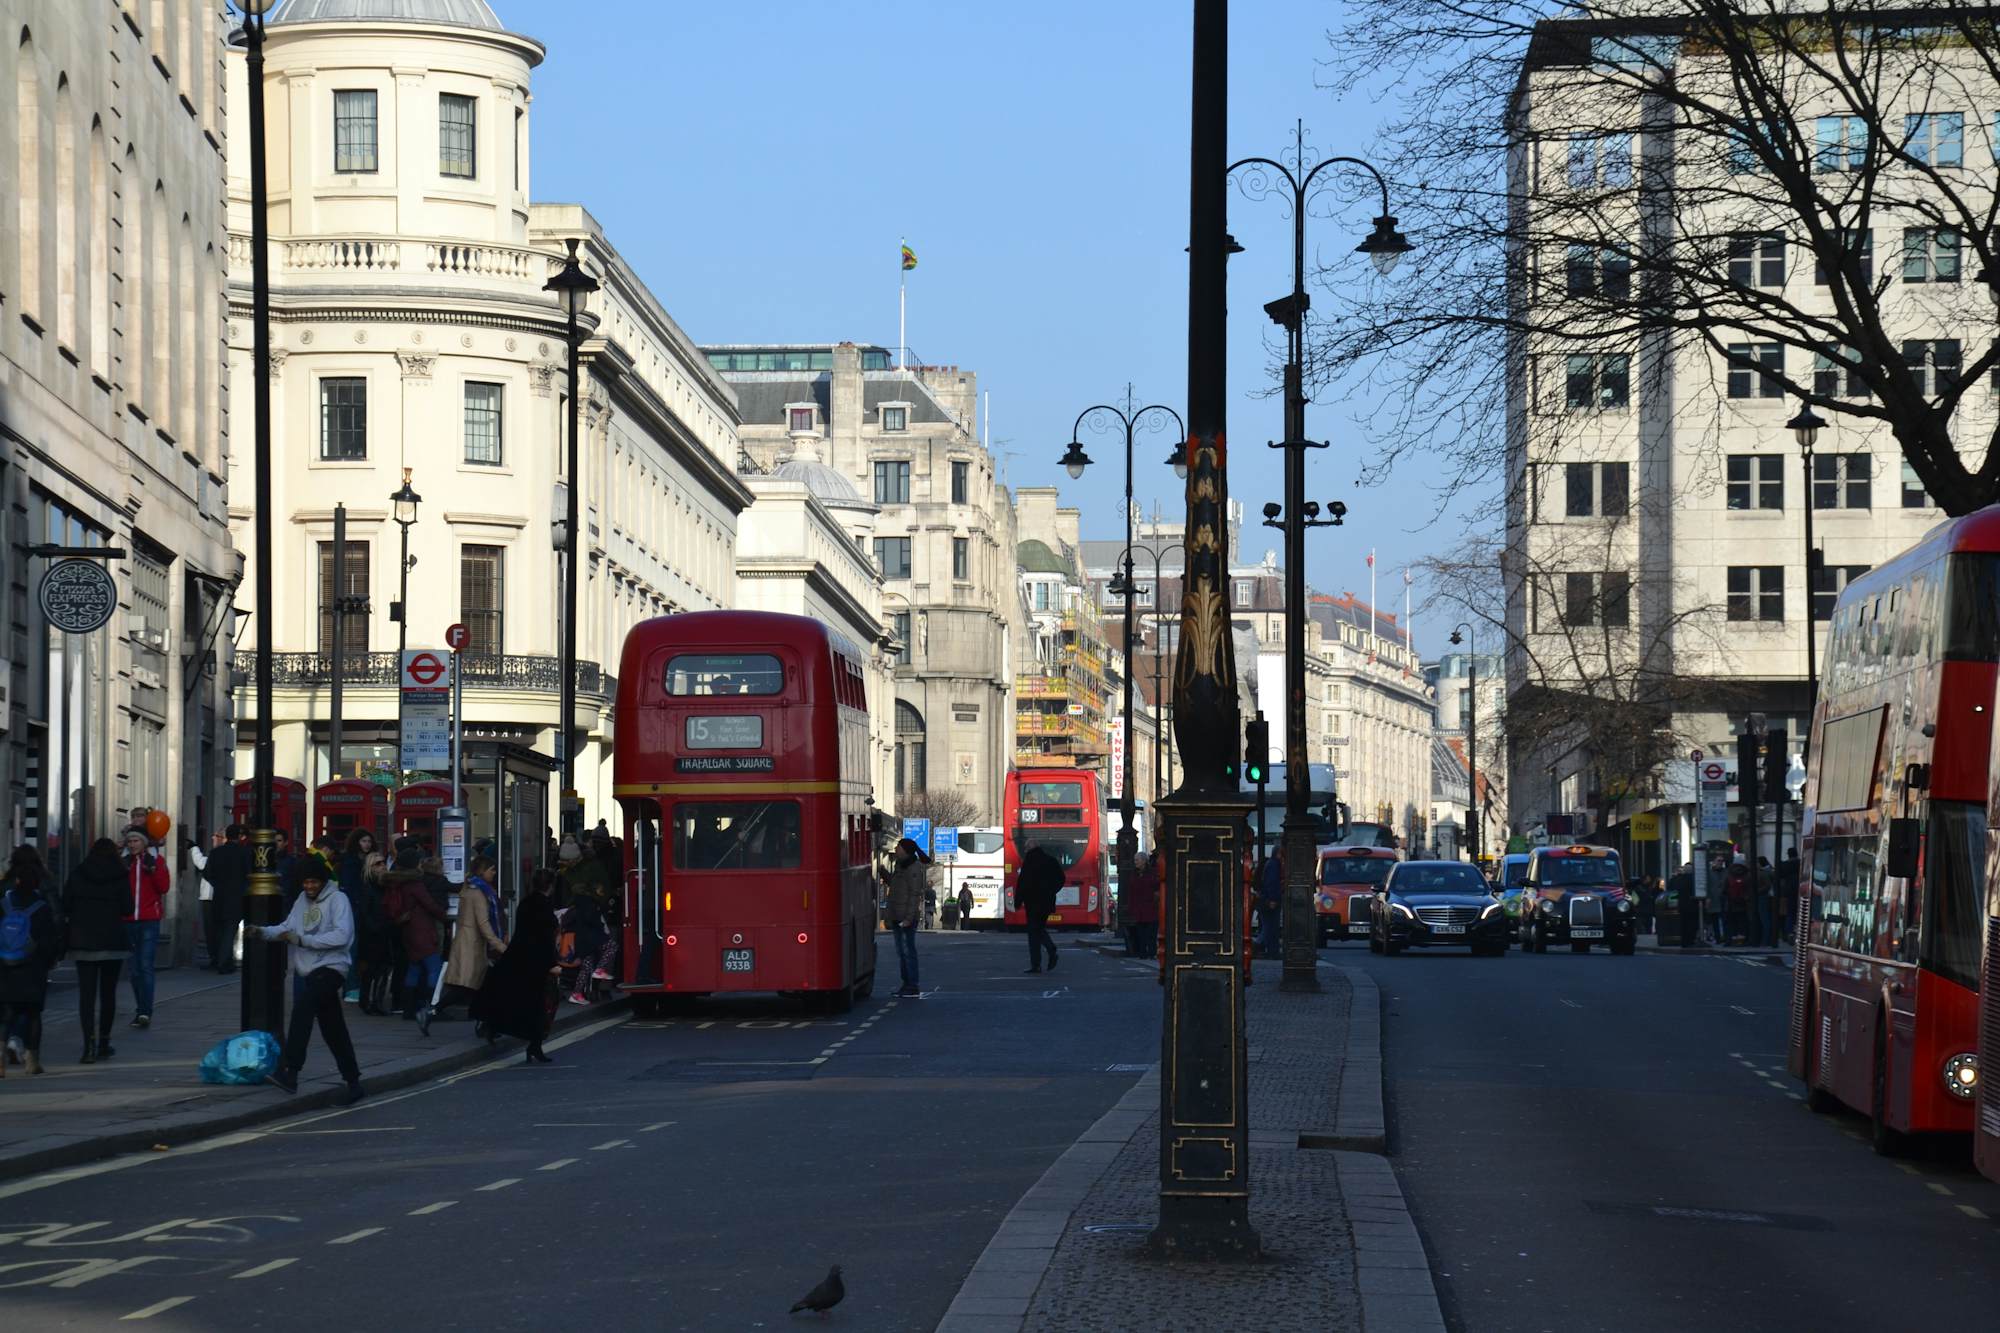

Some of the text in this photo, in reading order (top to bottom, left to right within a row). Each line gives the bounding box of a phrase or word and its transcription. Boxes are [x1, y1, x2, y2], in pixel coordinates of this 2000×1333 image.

[60, 585, 96, 594] PIZZA
[49, 594, 107, 604] EXPRESS
[453, 628, 464, 645] F
[691, 719, 709, 740] 15
[681, 758, 772, 769] TRAFALGAR SQUARE
[1022, 811, 1038, 822] 139
[1635, 821, 1655, 831] itsu
[727, 951, 749, 961] ALD
[725, 961, 750, 971] 933B
